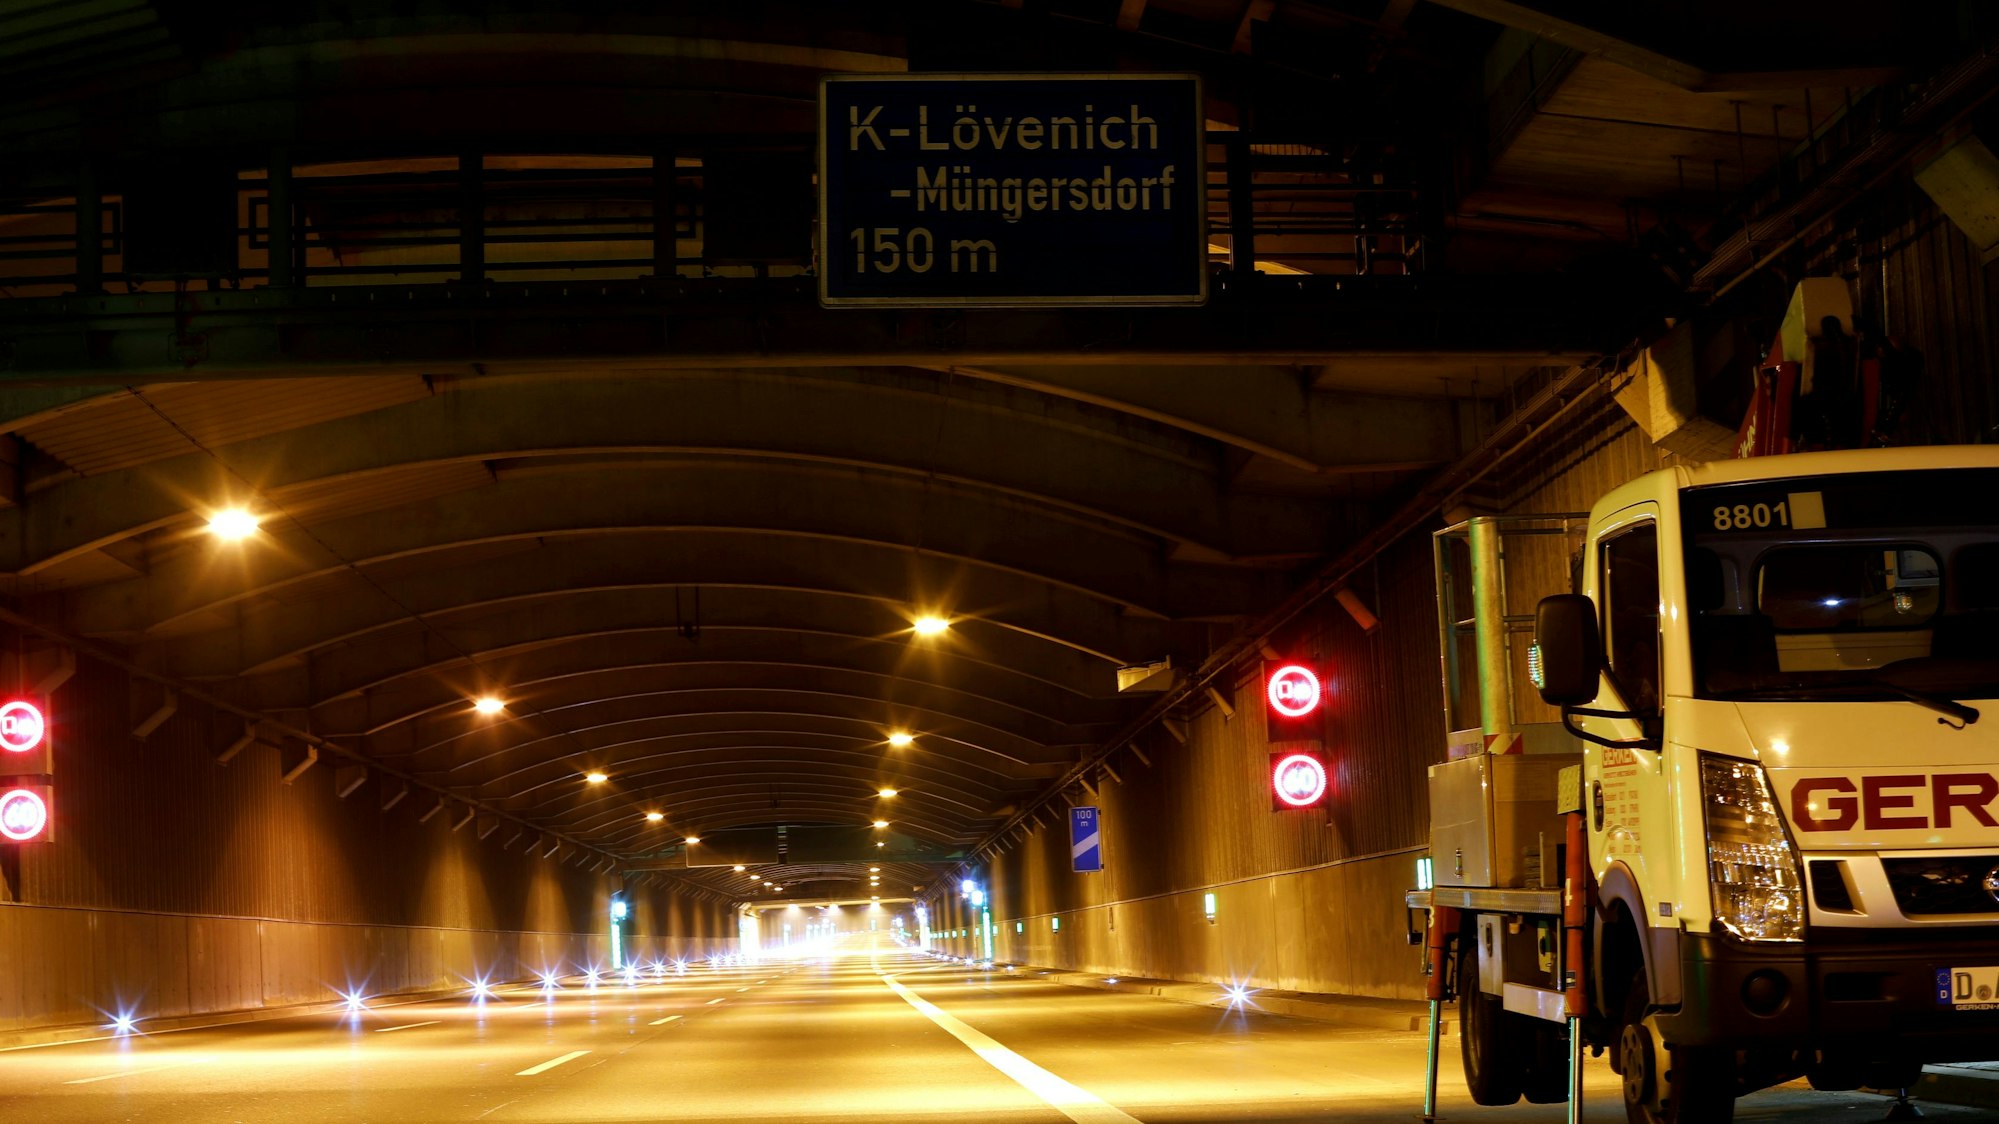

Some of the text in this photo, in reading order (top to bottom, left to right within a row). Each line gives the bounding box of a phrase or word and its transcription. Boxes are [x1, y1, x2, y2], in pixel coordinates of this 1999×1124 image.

[849, 104, 1159, 151] K-Lövenich
[889, 164, 1176, 223] -Müngersdorf
[850, 226, 998, 274] 150 m
[1713, 502, 1790, 531] 8801
[1076, 810, 1092, 819] 100
[1791, 773, 1999, 832] GER
[1940, 990, 1947, 999] D
